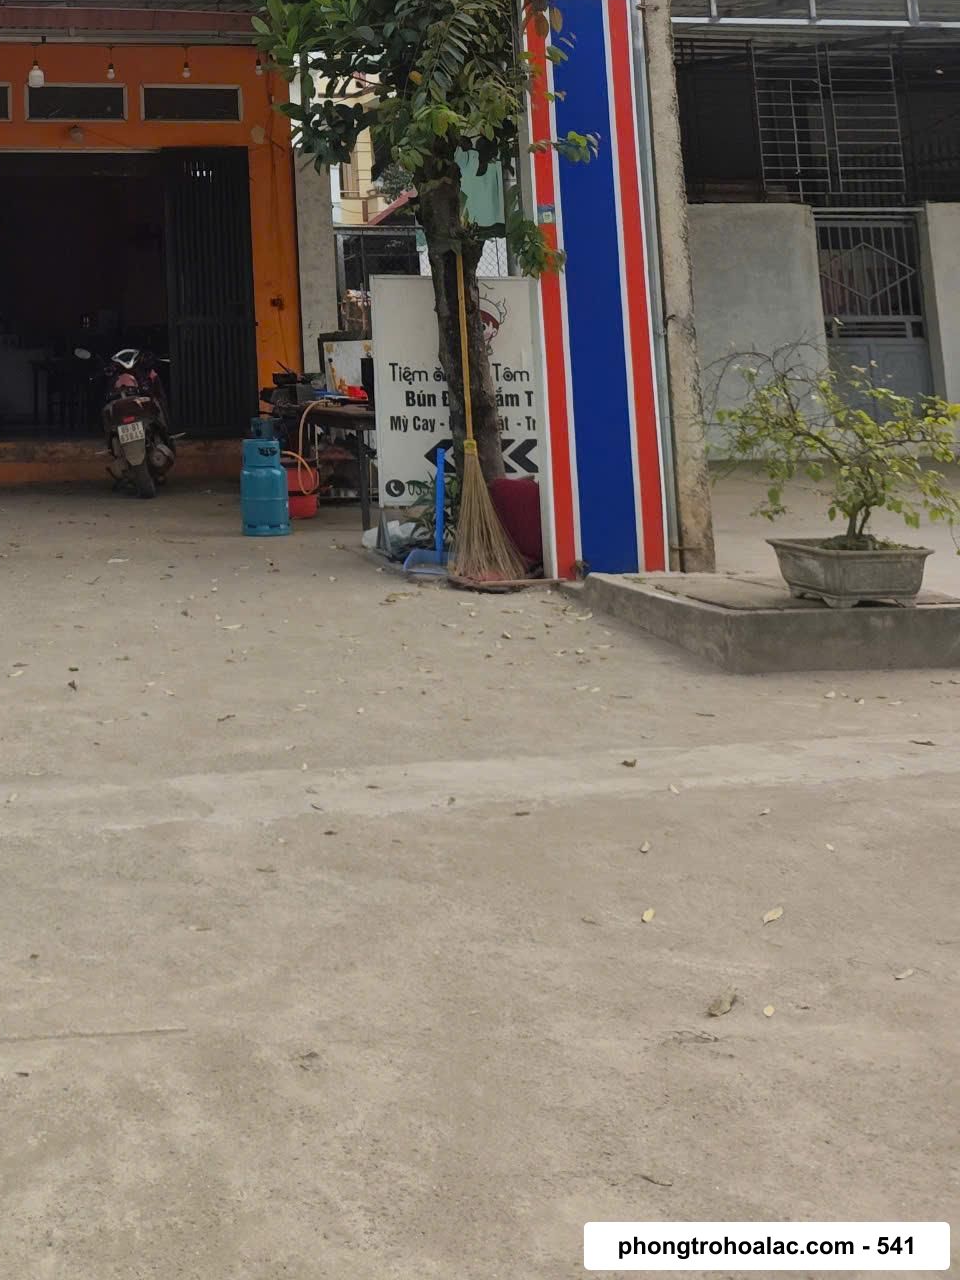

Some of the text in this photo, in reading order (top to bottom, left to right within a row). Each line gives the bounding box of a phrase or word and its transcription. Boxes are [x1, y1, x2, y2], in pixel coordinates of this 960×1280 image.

[389, 363, 429, 385] Tiệm
[492, 363, 530, 382] Tôm
[405, 390, 437, 407] Bún
[390, 415, 409, 432] Mỳ
[413, 415, 436, 432] Cay
